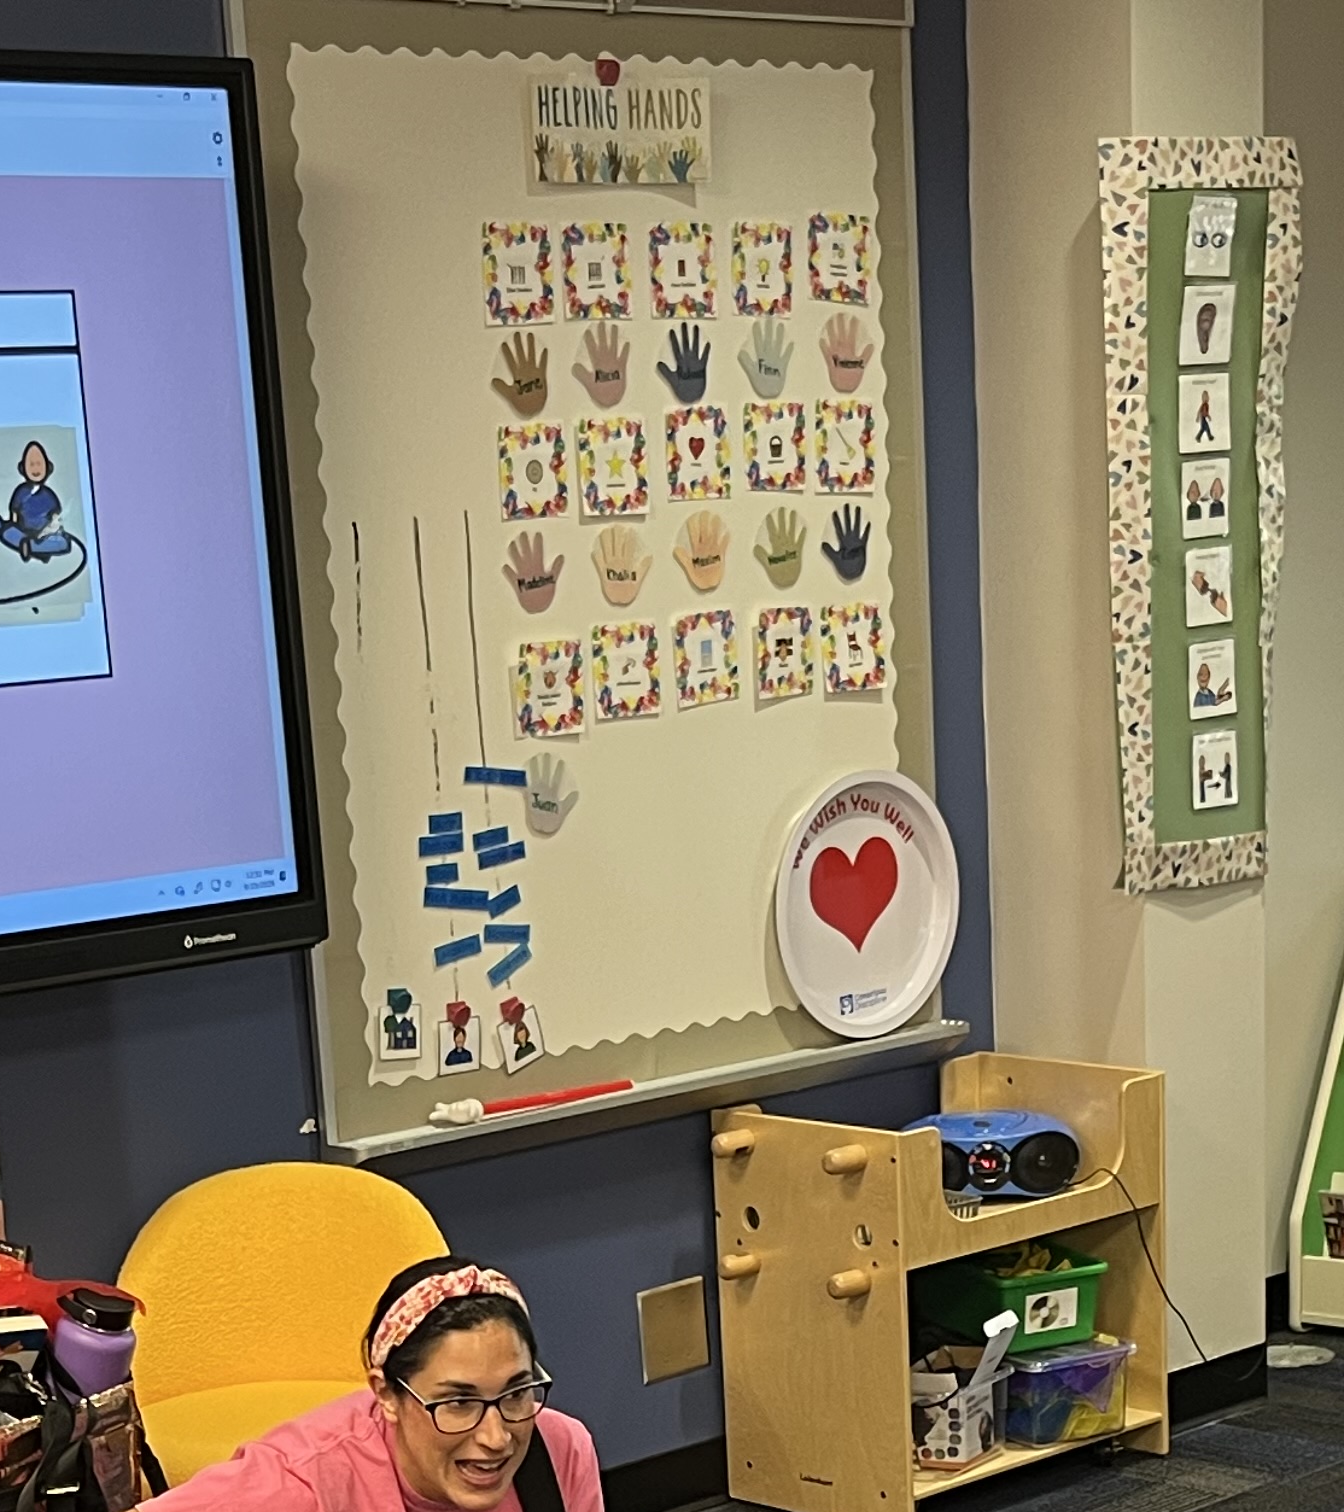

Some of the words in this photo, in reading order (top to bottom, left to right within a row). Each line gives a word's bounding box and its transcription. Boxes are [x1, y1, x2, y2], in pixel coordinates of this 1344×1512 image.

[538, 84, 618, 131] HELPING
[627, 87, 702, 131] HANDS
[809, 798, 847, 835] Wish
[850, 793, 880, 814] You
[884, 802, 915, 844] Well
